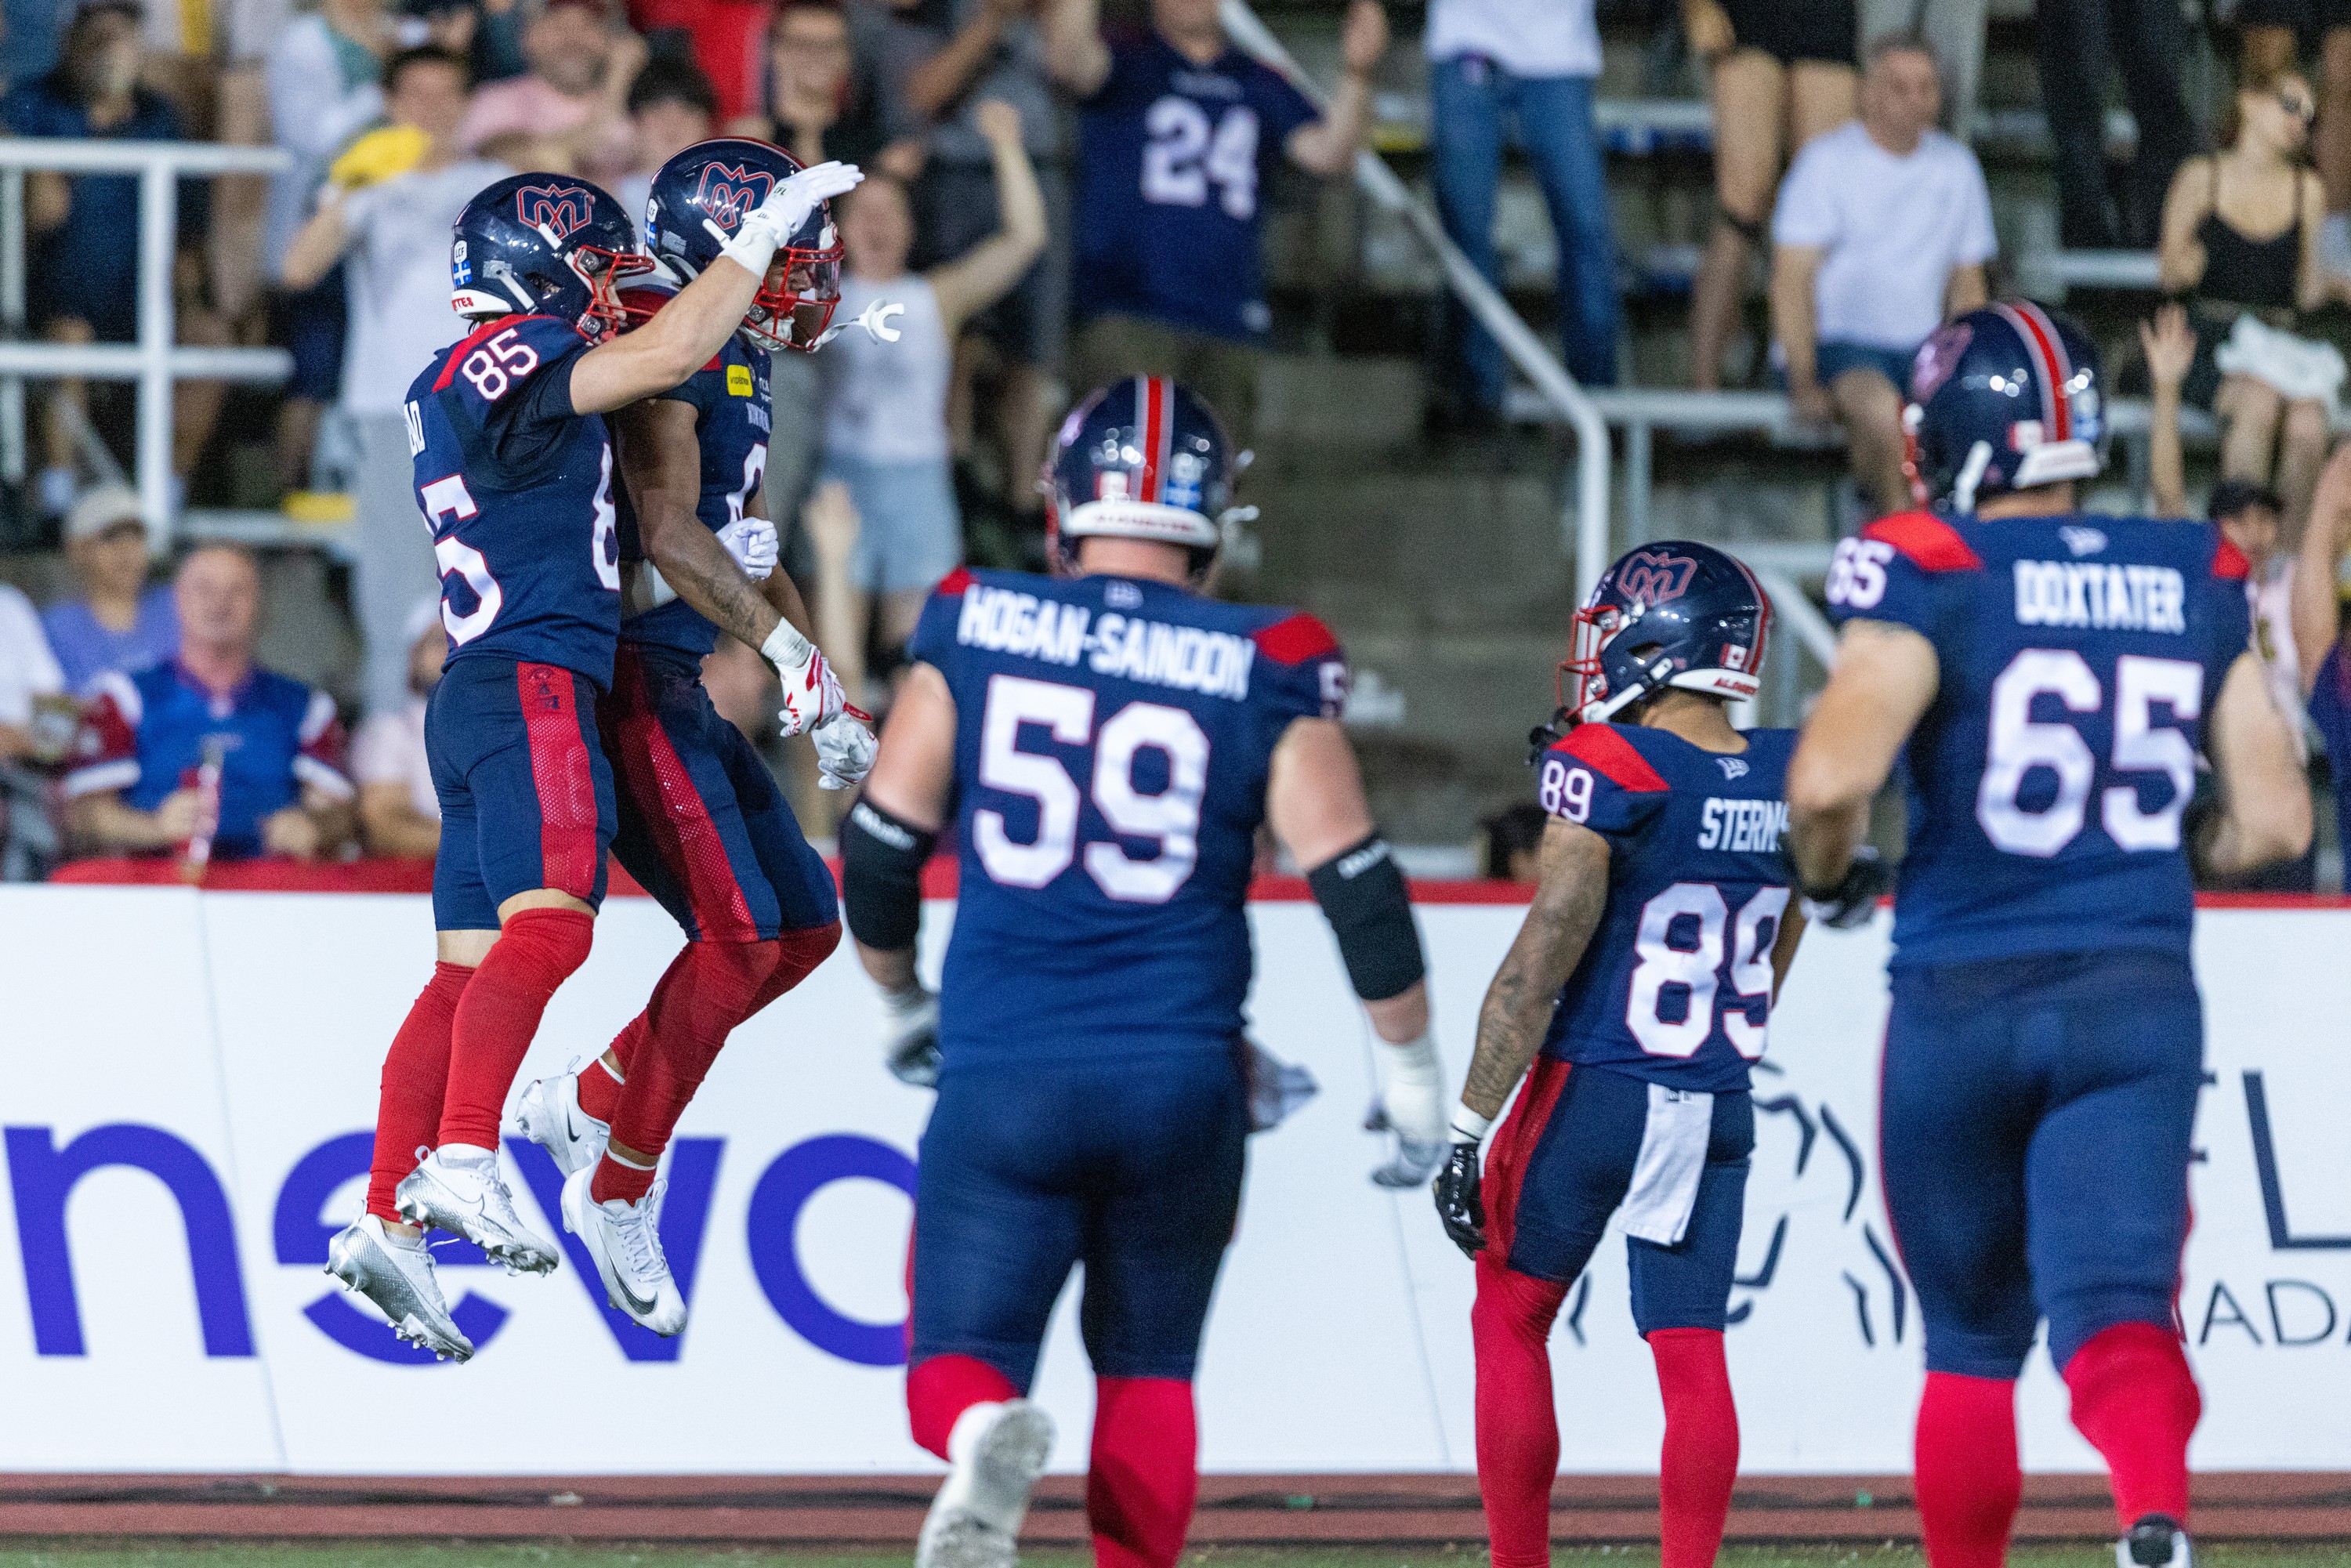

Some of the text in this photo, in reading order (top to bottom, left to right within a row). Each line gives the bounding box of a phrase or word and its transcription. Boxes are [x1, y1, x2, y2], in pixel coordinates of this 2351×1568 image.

[1142, 95, 1259, 220] 24
[462, 328, 539, 401] 85
[418, 473, 503, 647] 5
[1826, 535, 1896, 610] 65
[2013, 559, 2186, 635] DOXTATER
[956, 583, 1255, 701] HOGAN-SAINDON
[972, 673, 1212, 904] 59
[1539, 759, 1594, 825] 89
[1975, 647, 2204, 858] 65
[1625, 882, 1791, 1059] 89
[2198, 1280, 2351, 1347] AD
